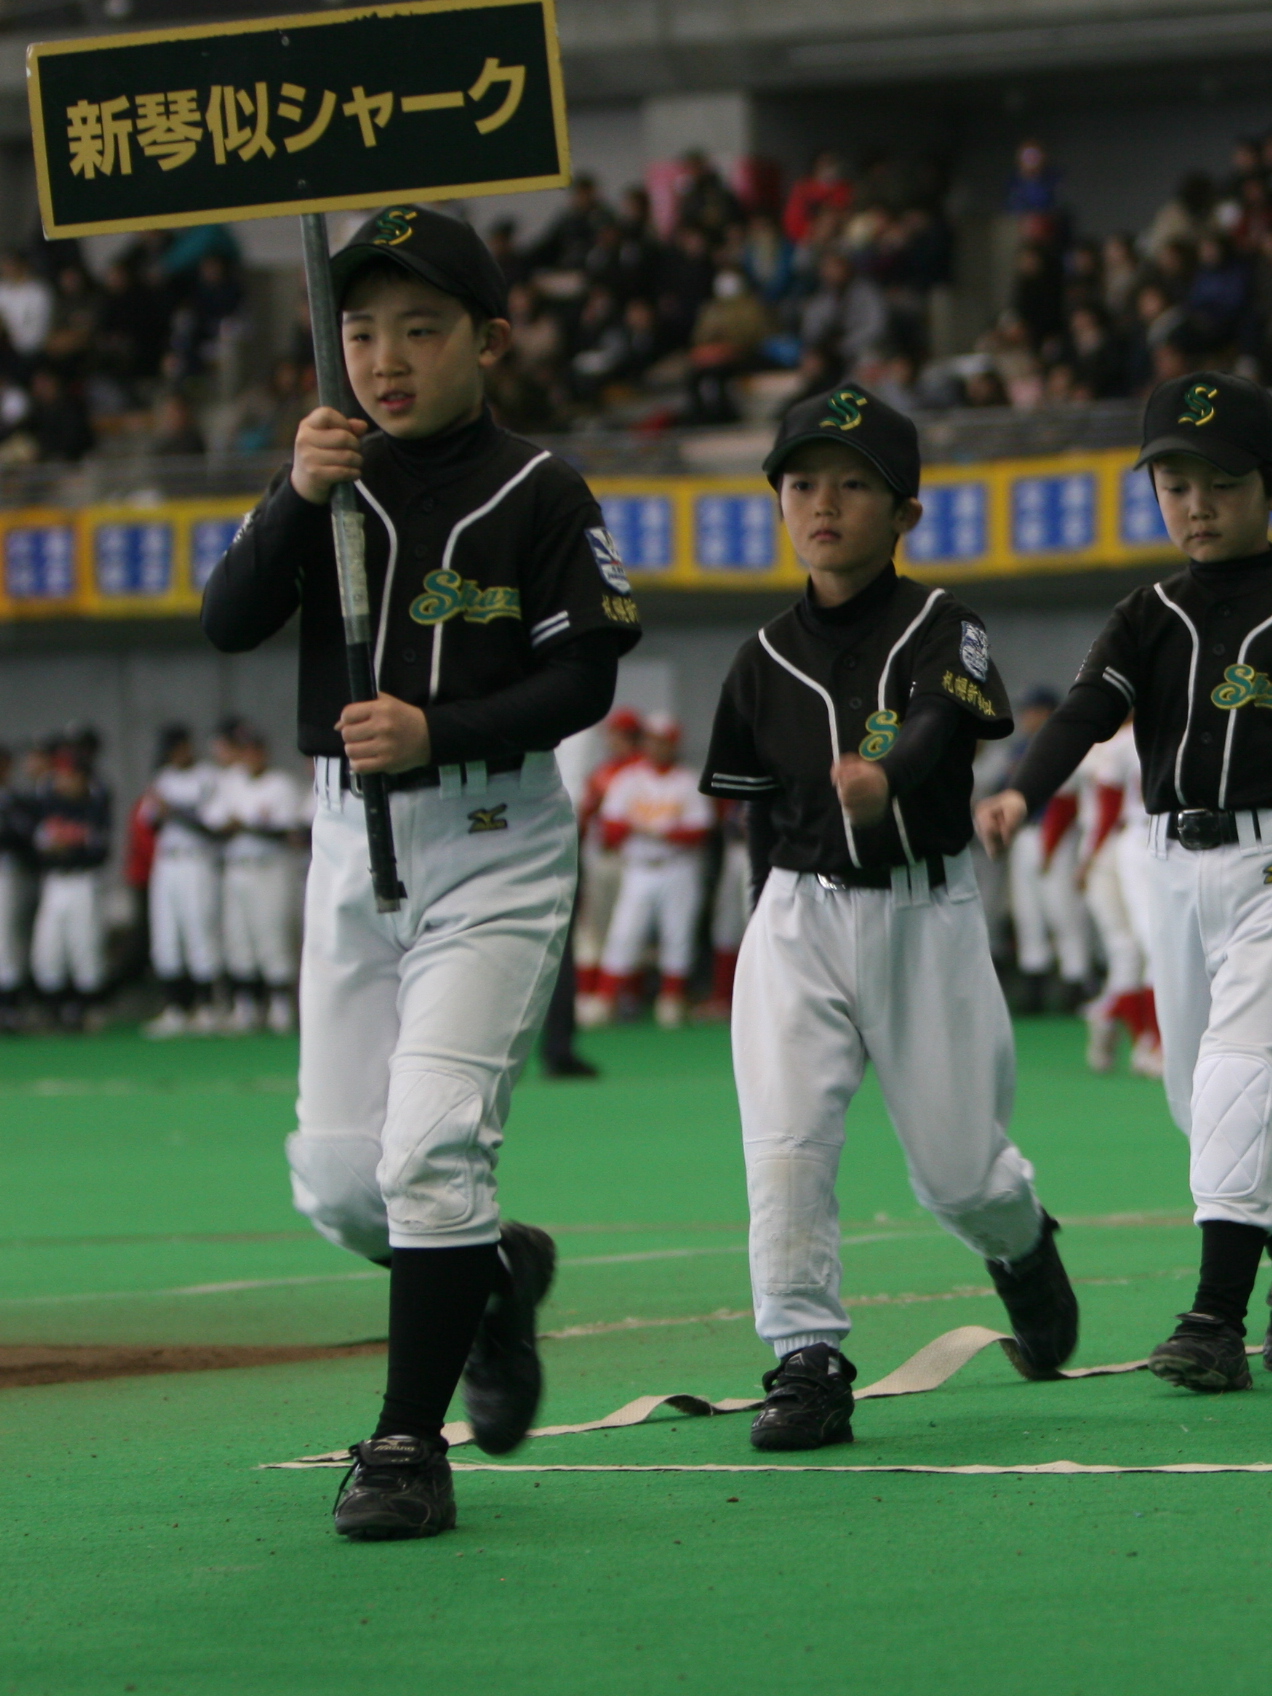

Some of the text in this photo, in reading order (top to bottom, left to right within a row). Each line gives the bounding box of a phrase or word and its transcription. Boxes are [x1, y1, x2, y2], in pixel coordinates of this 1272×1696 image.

[66, 57, 527, 180] 新琴似シャーク
[819, 389, 868, 431] S
[1178, 383, 1218, 427] S
